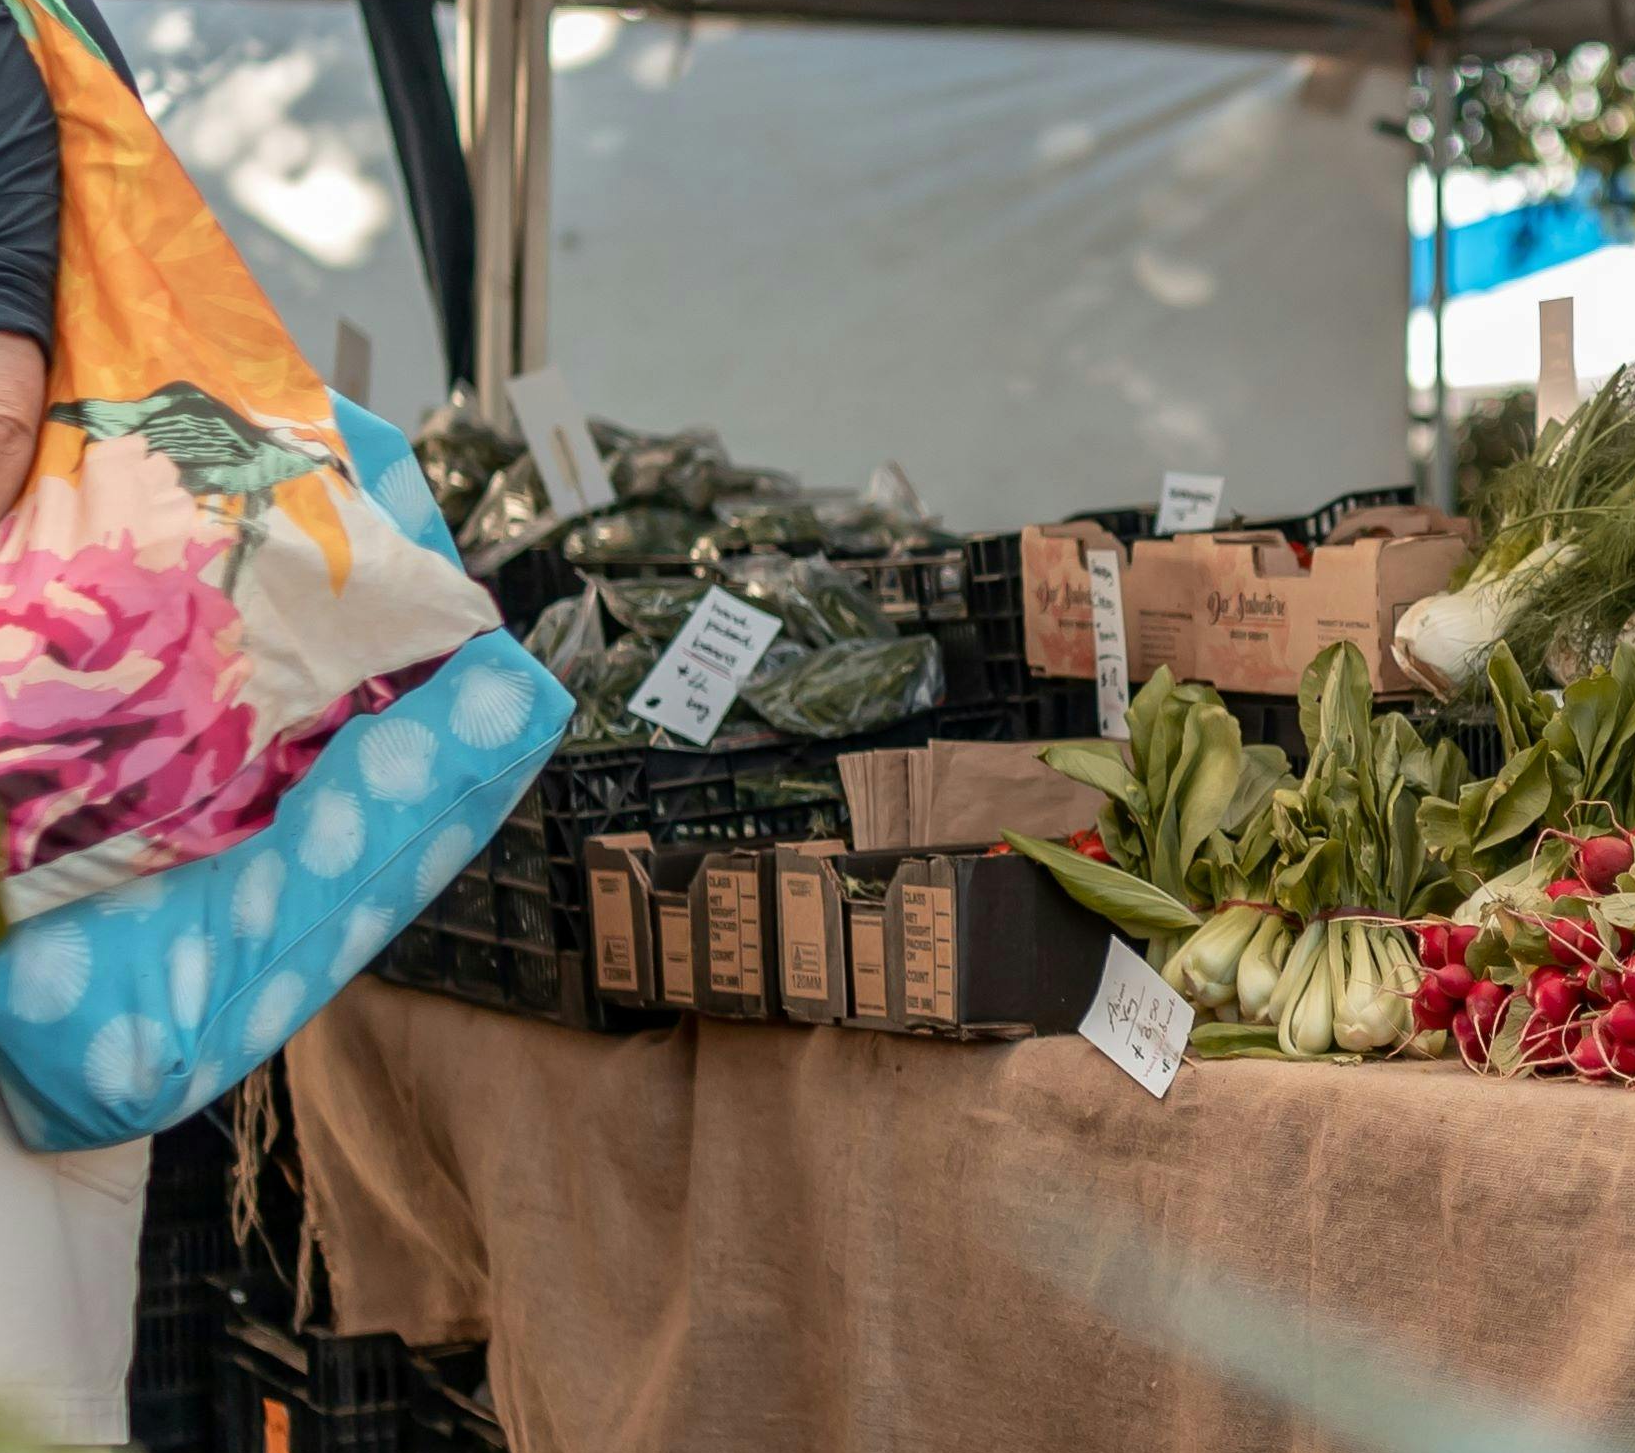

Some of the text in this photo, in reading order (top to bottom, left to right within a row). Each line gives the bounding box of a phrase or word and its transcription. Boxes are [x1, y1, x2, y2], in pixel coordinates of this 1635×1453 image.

[904, 892, 926, 906] CLASS
[905, 912, 918, 924] NET
[905, 925, 931, 937] WEIGHT
[906, 938, 932, 952] PACKED
[906, 970, 930, 984] COUNT
